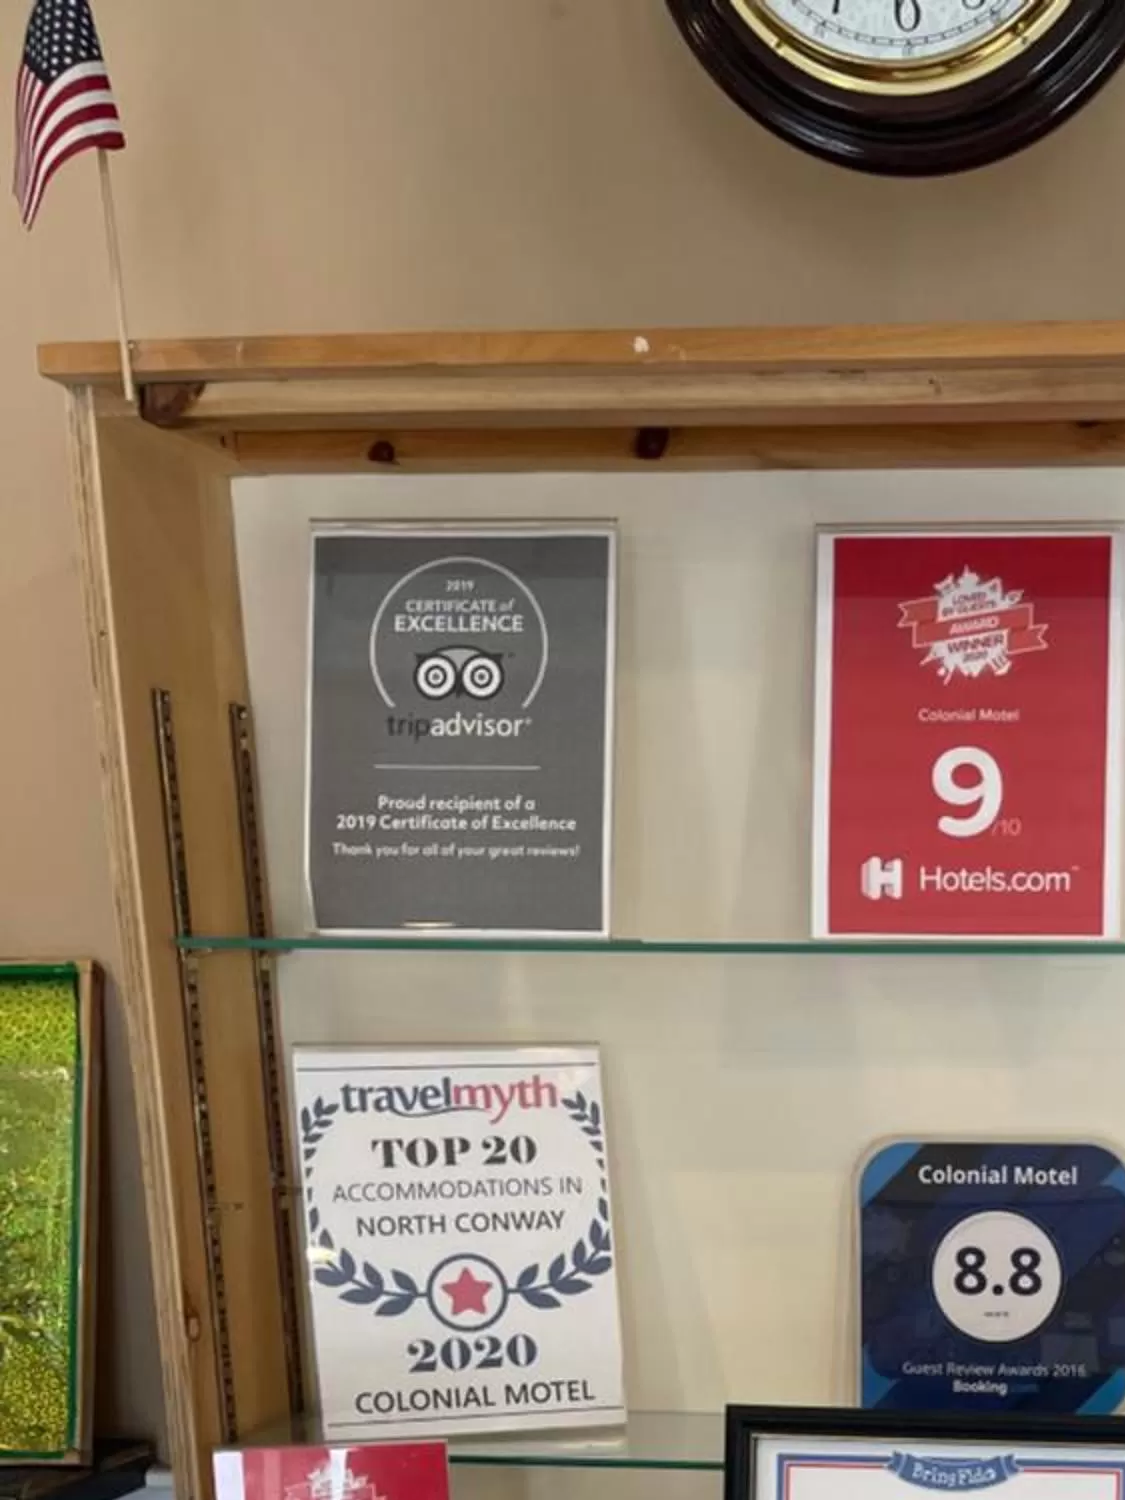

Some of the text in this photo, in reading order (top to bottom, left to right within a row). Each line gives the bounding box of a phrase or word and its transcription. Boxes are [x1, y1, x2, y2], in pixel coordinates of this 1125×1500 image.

[446, 580, 475, 592] 2019
[405, 598, 515, 613] CERTIFICATE of
[394, 614, 524, 633] EXCELLENCE
[949, 615, 999, 634] AWARD
[947, 634, 1004, 653] WINNER
[918, 707, 1020, 722] Colonial Motel
[386, 712, 524, 743] tripadvisor
[931, 745, 1003, 837] 9
[378, 794, 536, 814] Proud recipient of a
[336, 814, 577, 831] 2019 Certificate of Excellence
[332, 841, 372, 856] Thank
[375, 845, 399, 860] you
[400, 841, 421, 857] for
[422, 842, 440, 857] all
[441, 841, 456, 857] of
[457, 845, 485, 860] your
[488, 845, 525, 860] great
[918, 865, 1072, 893] Hotels.com
[341, 1075, 561, 1126] travelmyth
[371, 1135, 537, 1169] TOP 20
[918, 1164, 1078, 1186] Colonial Motel
[332, 1176, 583, 1203] ACCOMMODATIONS IN
[356, 1210, 565, 1238] NORTH CONWAY
[953, 1246, 1043, 1297] 8.8
[407, 1333, 537, 1373] 2020
[901, 1361, 943, 1376] Guest
[946, 1361, 995, 1377] Review
[997, 1362, 1049, 1377] Awards
[355, 1379, 596, 1415] COLONIAL MOTEL
[912, 1462, 997, 1487] BringFido
